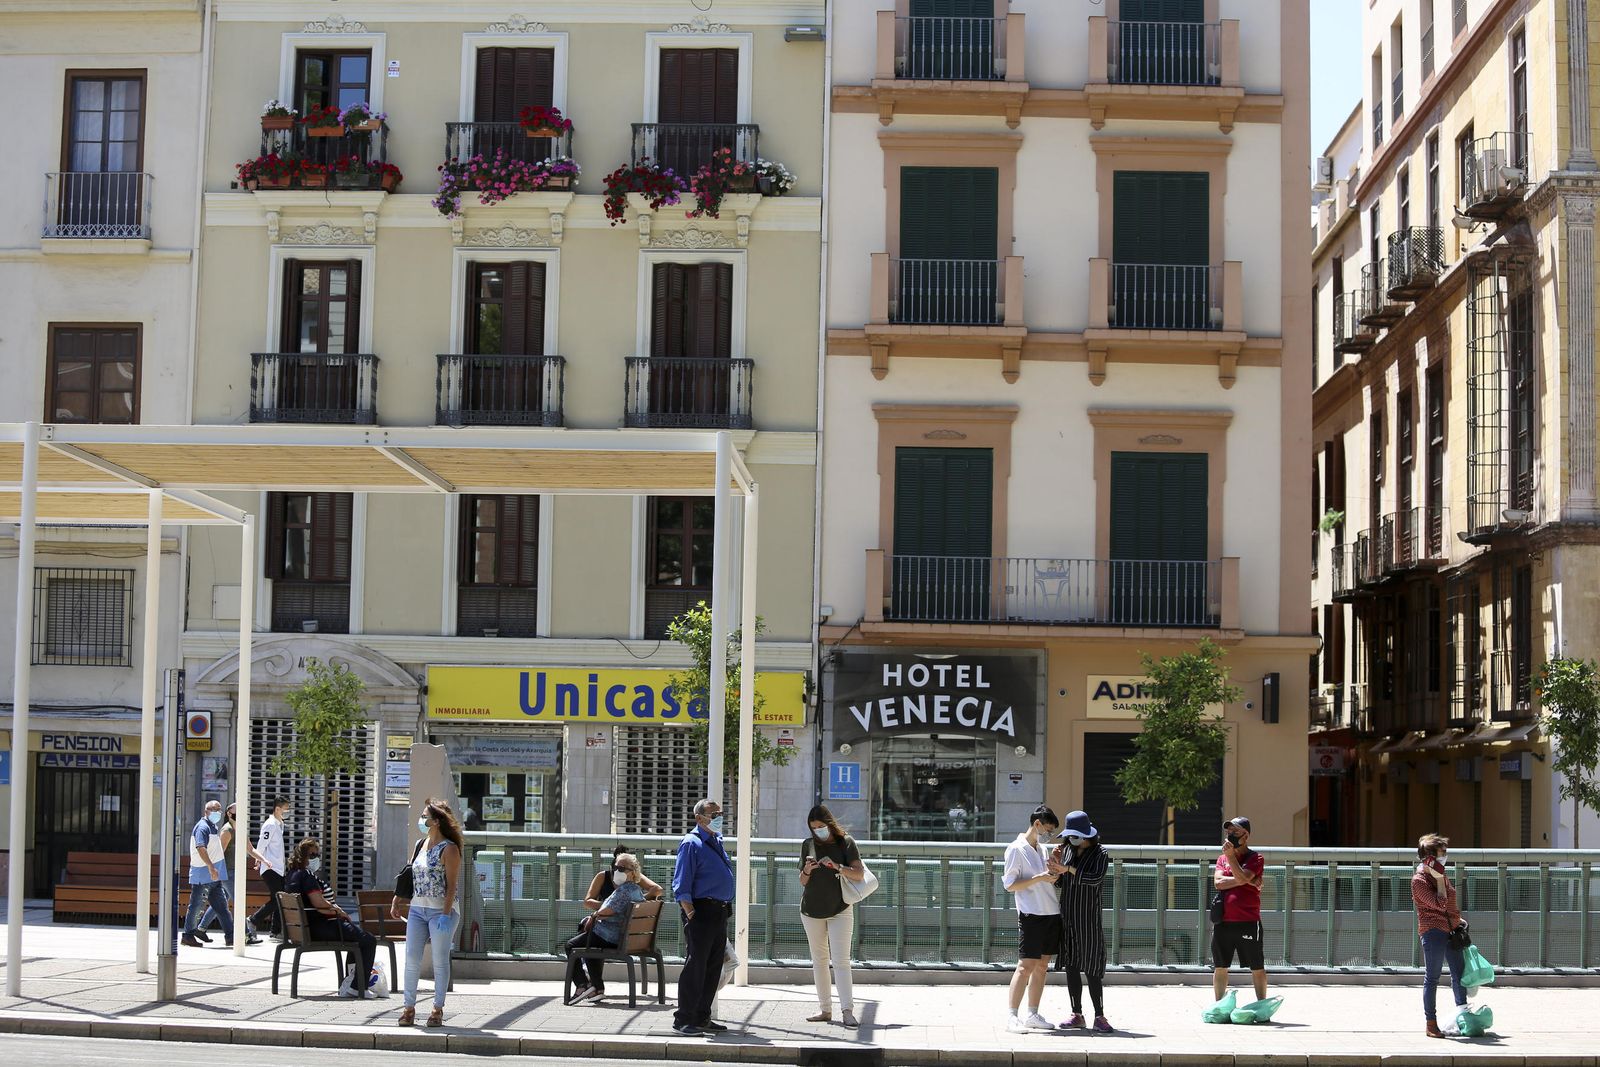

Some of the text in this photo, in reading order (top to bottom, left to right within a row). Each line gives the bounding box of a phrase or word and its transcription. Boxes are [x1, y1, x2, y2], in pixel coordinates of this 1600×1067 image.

[882, 663, 991, 688] HOTEL
[519, 671, 710, 719] Unicasa
[435, 707, 491, 716] INMOBILIARIA
[849, 694, 1015, 737] VENECIA
[41, 734, 122, 752] PENSION
[43, 753, 141, 768] AVENIDA
[837, 765, 853, 783] H
[263, 831, 270, 840] 3
